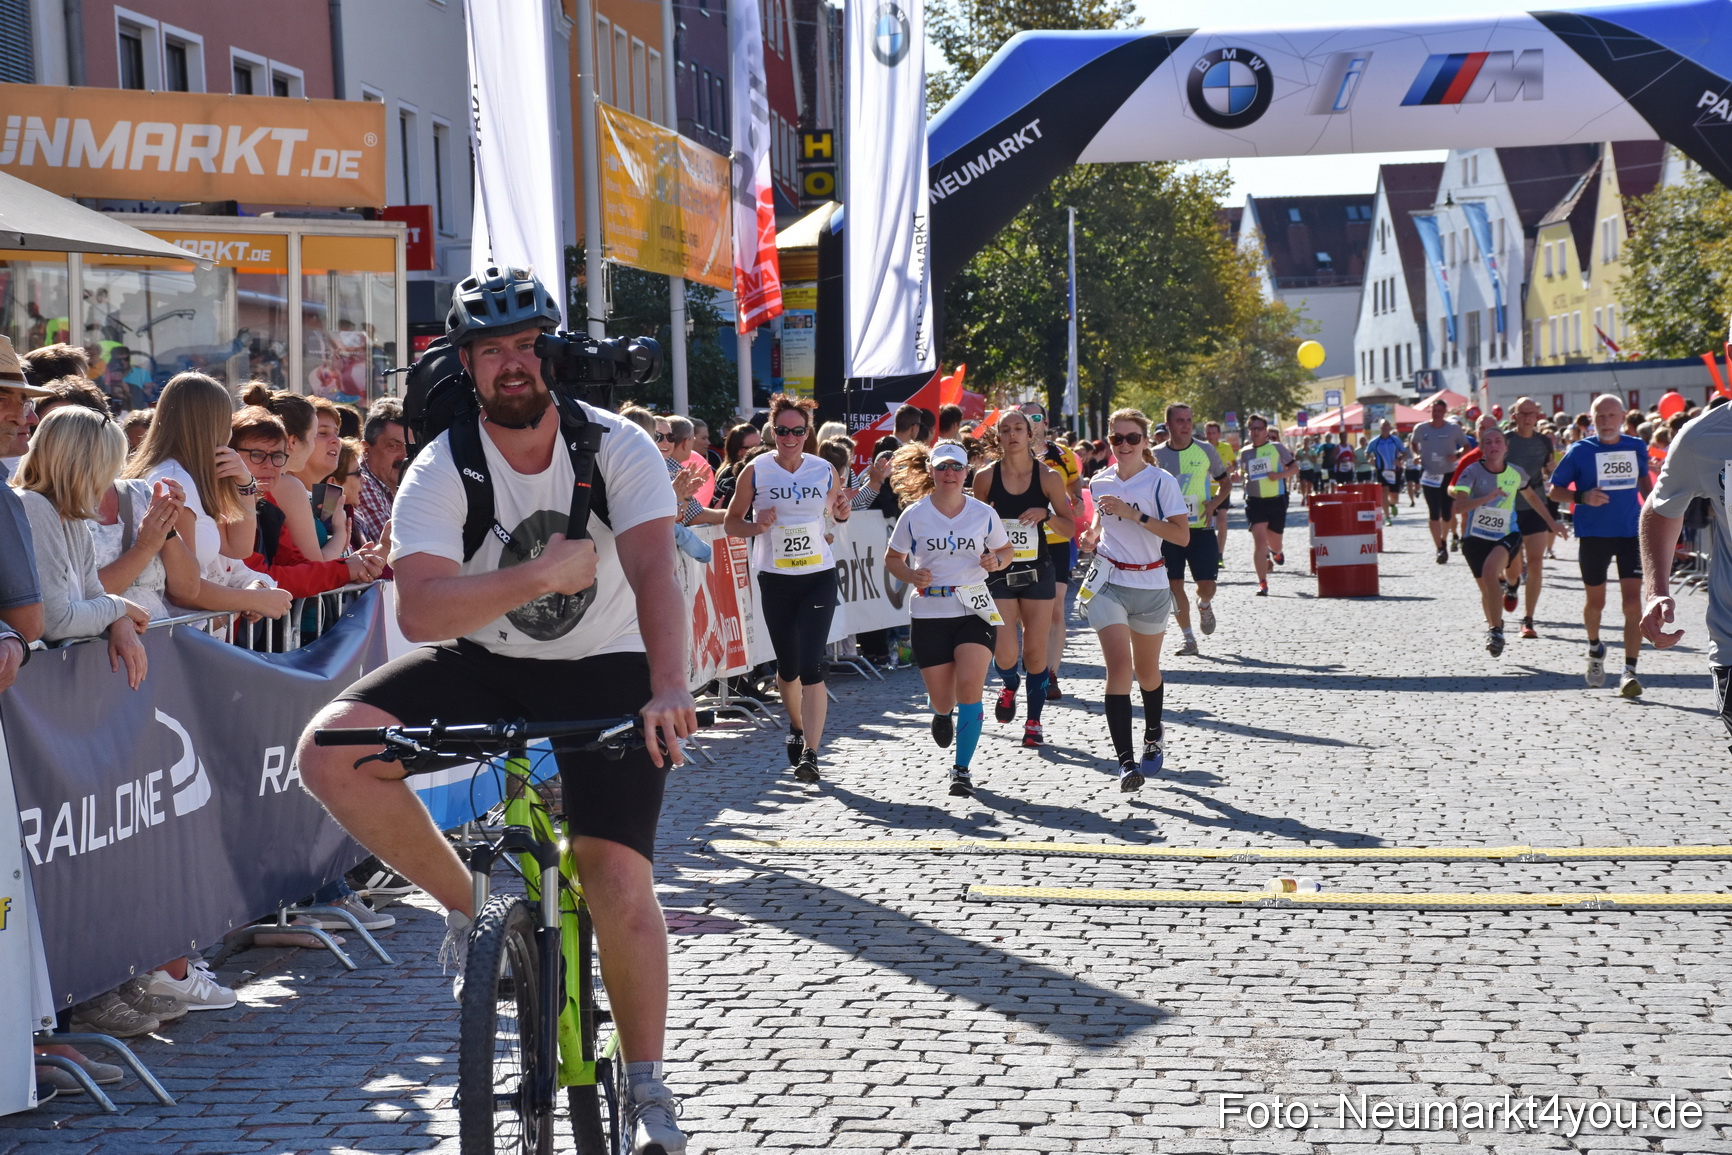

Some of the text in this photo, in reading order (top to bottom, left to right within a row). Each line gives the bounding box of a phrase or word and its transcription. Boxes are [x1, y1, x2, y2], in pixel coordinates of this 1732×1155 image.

[1195, 49, 1265, 73] BMW
[1697, 90, 1732, 123] PA
[929, 118, 1043, 205] NEUMARKT
[859, 413, 881, 422] NEXT
[845, 421, 871, 430] EARS
[1252, 463, 1268, 472] 3091
[1603, 461, 1633, 475] 2568
[1478, 514, 1504, 528] 2239
[783, 535, 811, 552] 252
[791, 559, 808, 567] Katja
[835, 541, 881, 602] arkt
[20, 769, 165, 866] RAIL.ONE
